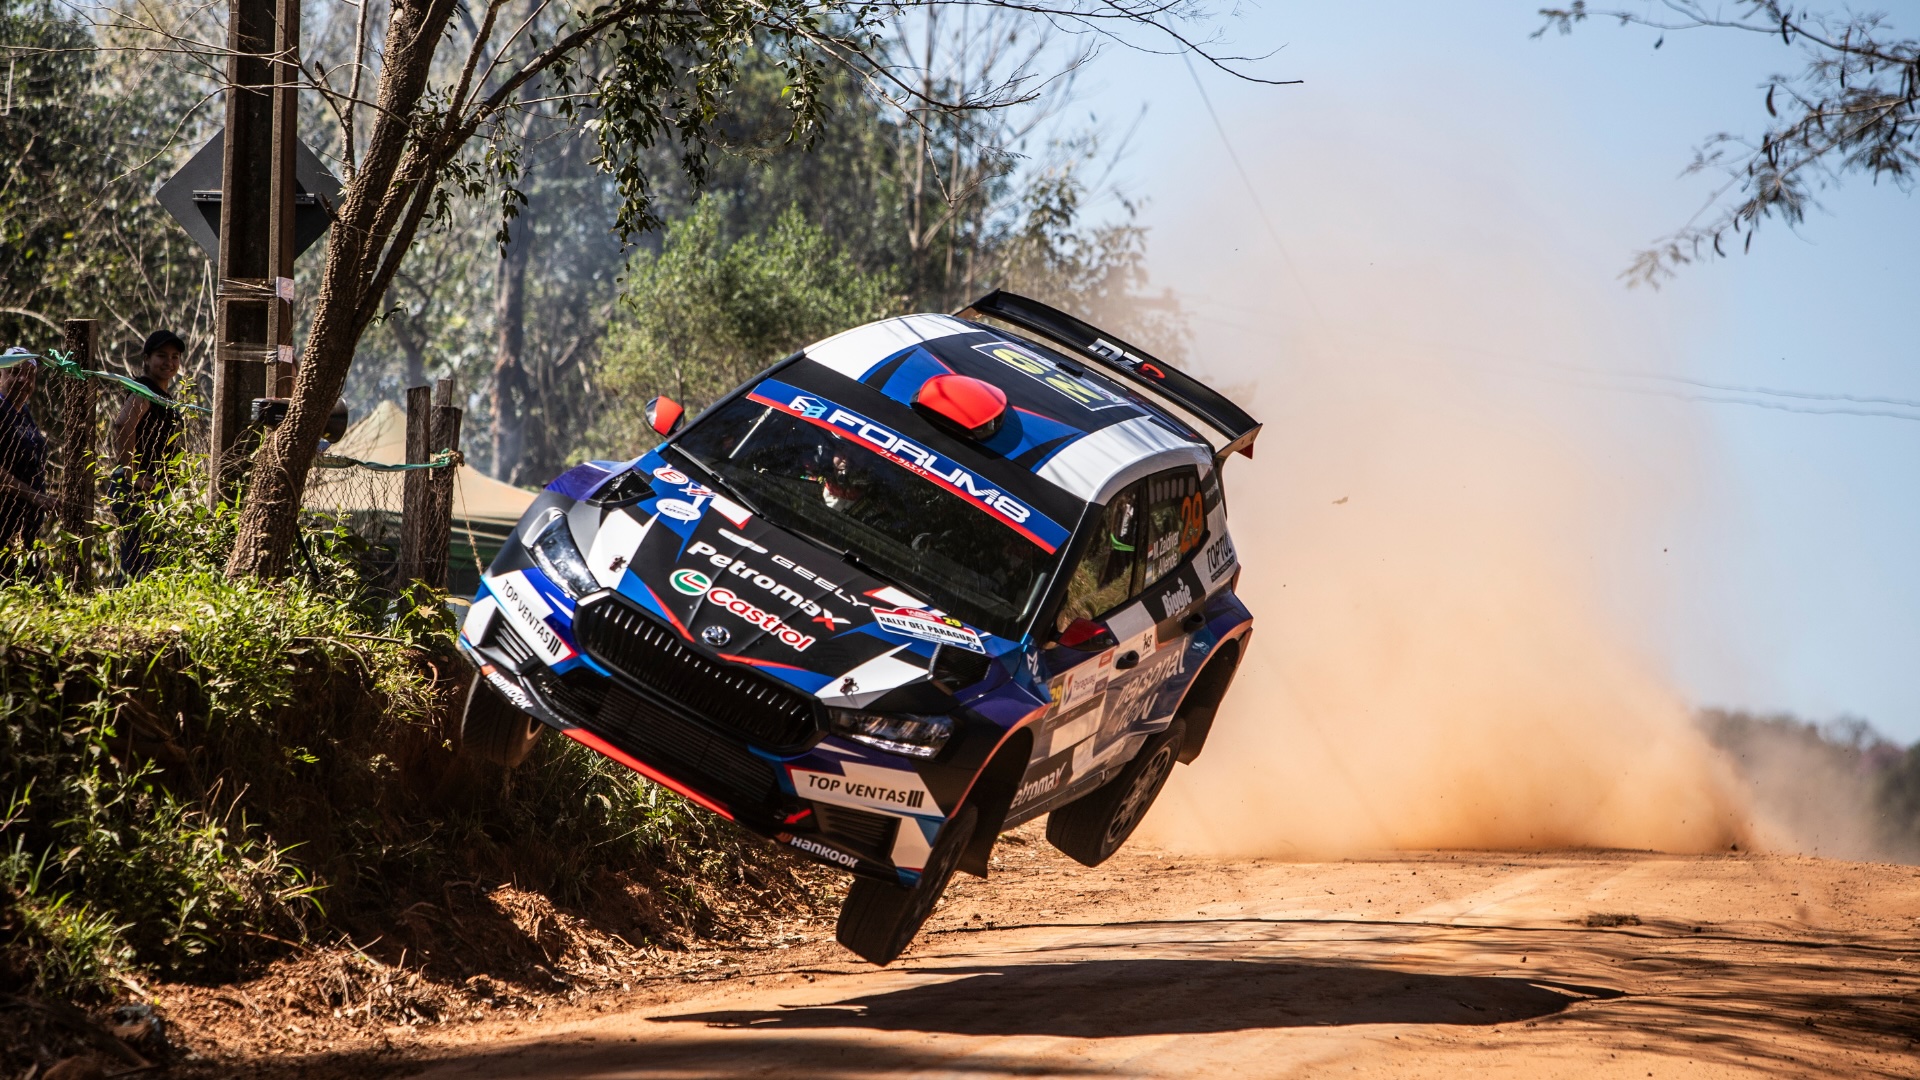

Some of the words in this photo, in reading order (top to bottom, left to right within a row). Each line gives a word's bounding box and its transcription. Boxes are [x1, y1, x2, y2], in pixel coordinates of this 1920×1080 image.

[827, 408, 1031, 523] FORUM8
[1180, 491, 1204, 555] 29
[771, 554, 870, 608] GEELY
[501, 578, 518, 604] TOP
[517, 602, 551, 644] VENTAS
[708, 588, 815, 651] Castrol
[879, 616, 906, 627] RALLY
[908, 621, 925, 632] DEL
[927, 625, 977, 644] PARAGUAY
[942, 616, 962, 628] 29
[808, 774, 841, 792] TOP
[845, 782, 907, 804] VENTAS
[1010, 762, 1068, 810] etromax
